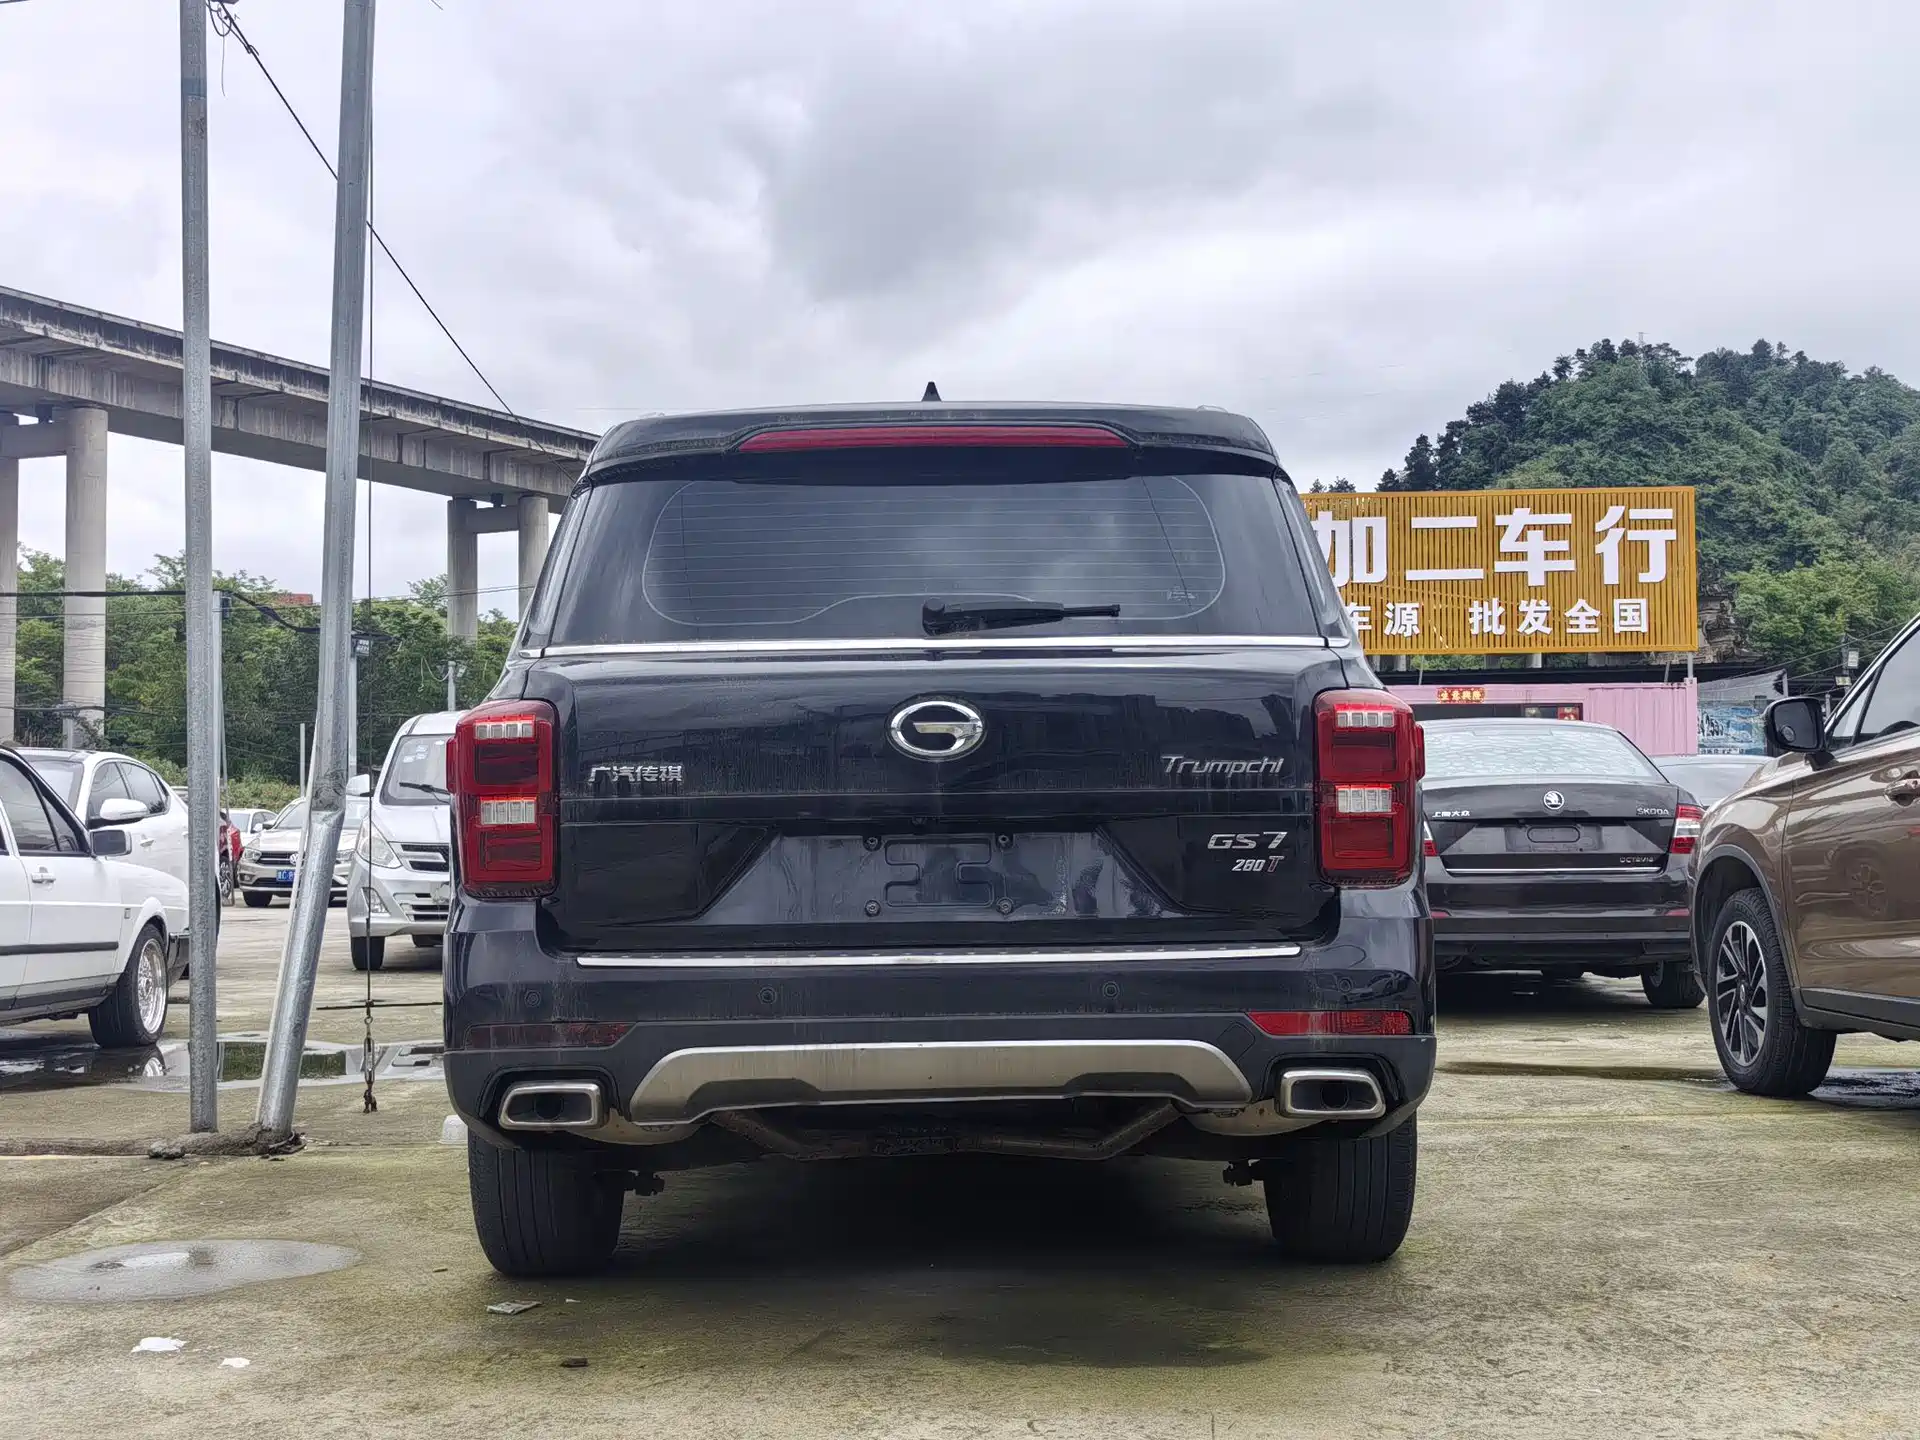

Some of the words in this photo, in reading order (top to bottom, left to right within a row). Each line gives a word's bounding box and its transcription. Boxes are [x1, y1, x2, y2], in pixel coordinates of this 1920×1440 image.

[1310, 505, 1677, 588] 加二车行
[1468, 597, 1648, 636] 批发全国
[588, 765, 682, 782] 广汽传祺
[1161, 755, 1285, 778] Trumpchi
